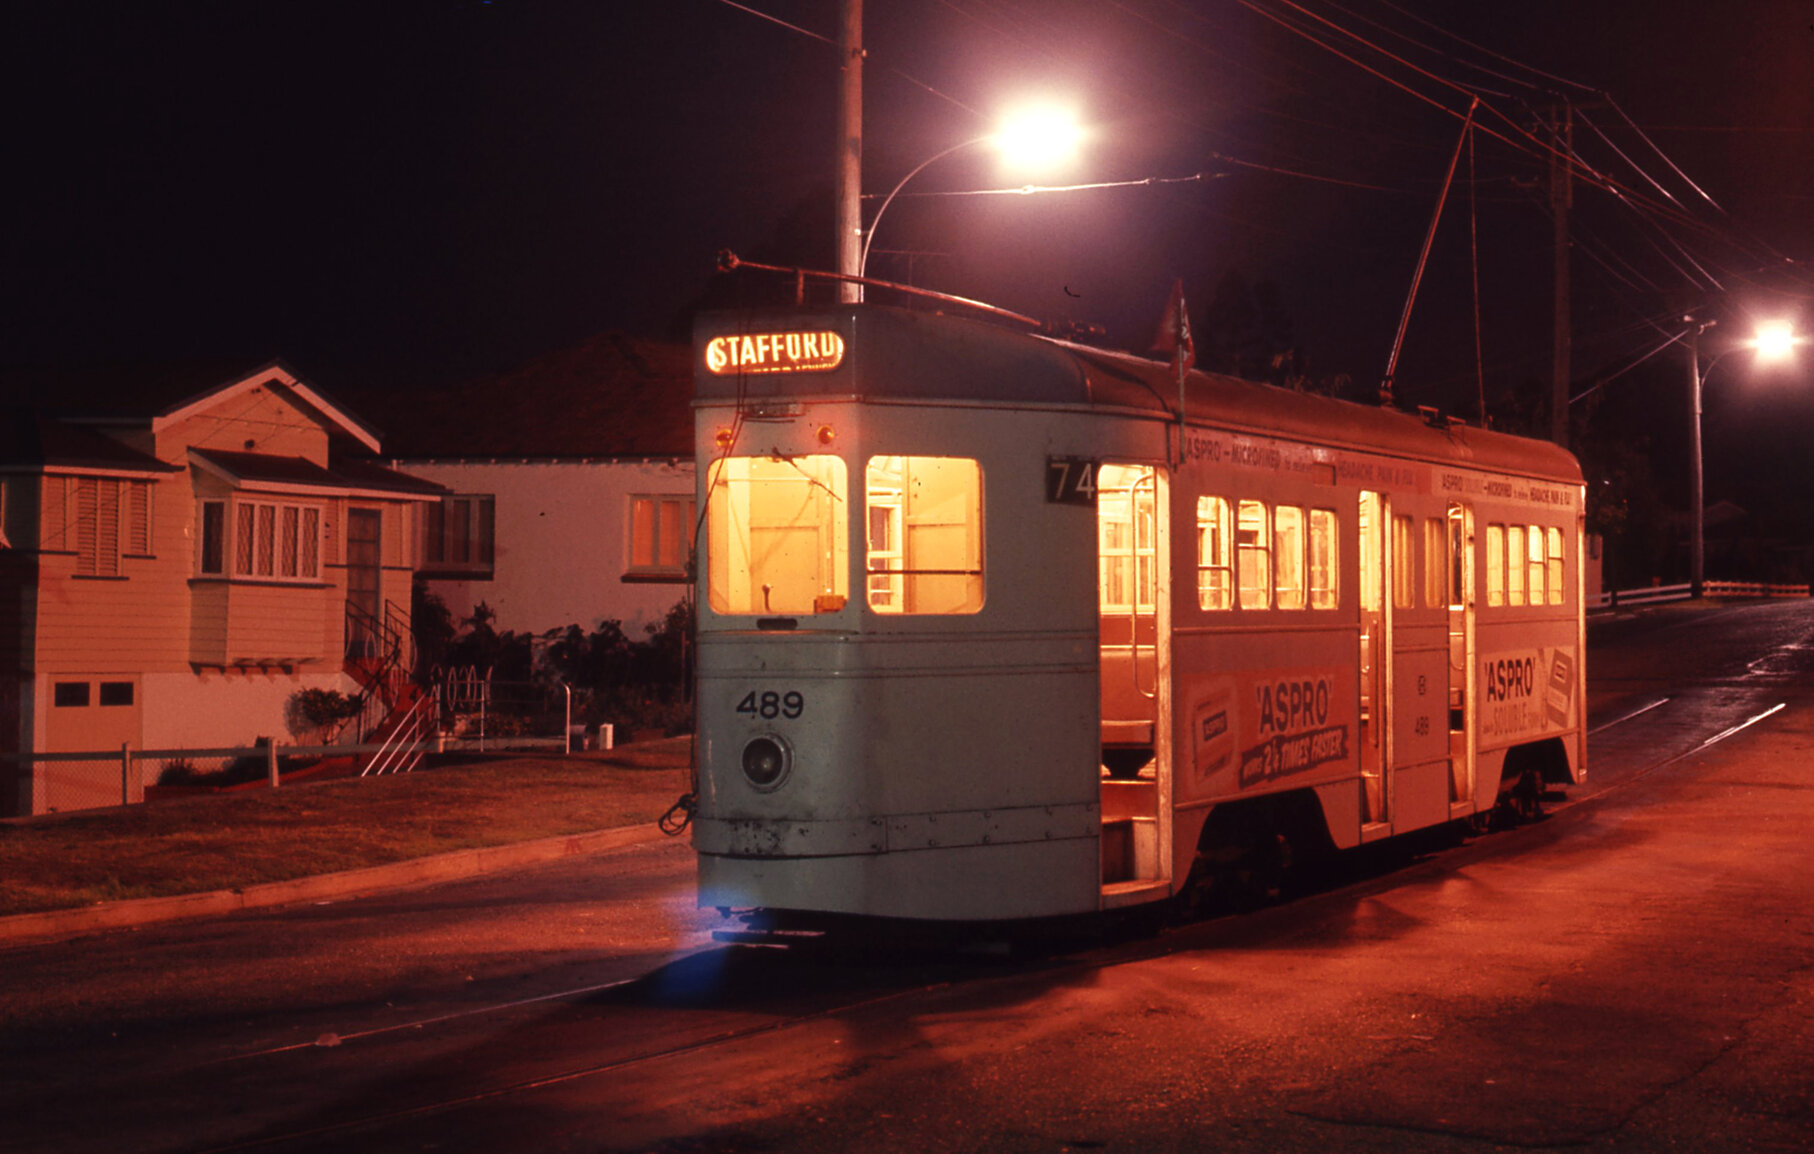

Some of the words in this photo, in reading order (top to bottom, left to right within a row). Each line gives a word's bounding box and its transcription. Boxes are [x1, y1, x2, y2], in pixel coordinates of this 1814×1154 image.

[712, 332, 836, 366] STAFFORD
[1051, 463, 1094, 500] 74
[736, 690, 804, 720] 489
